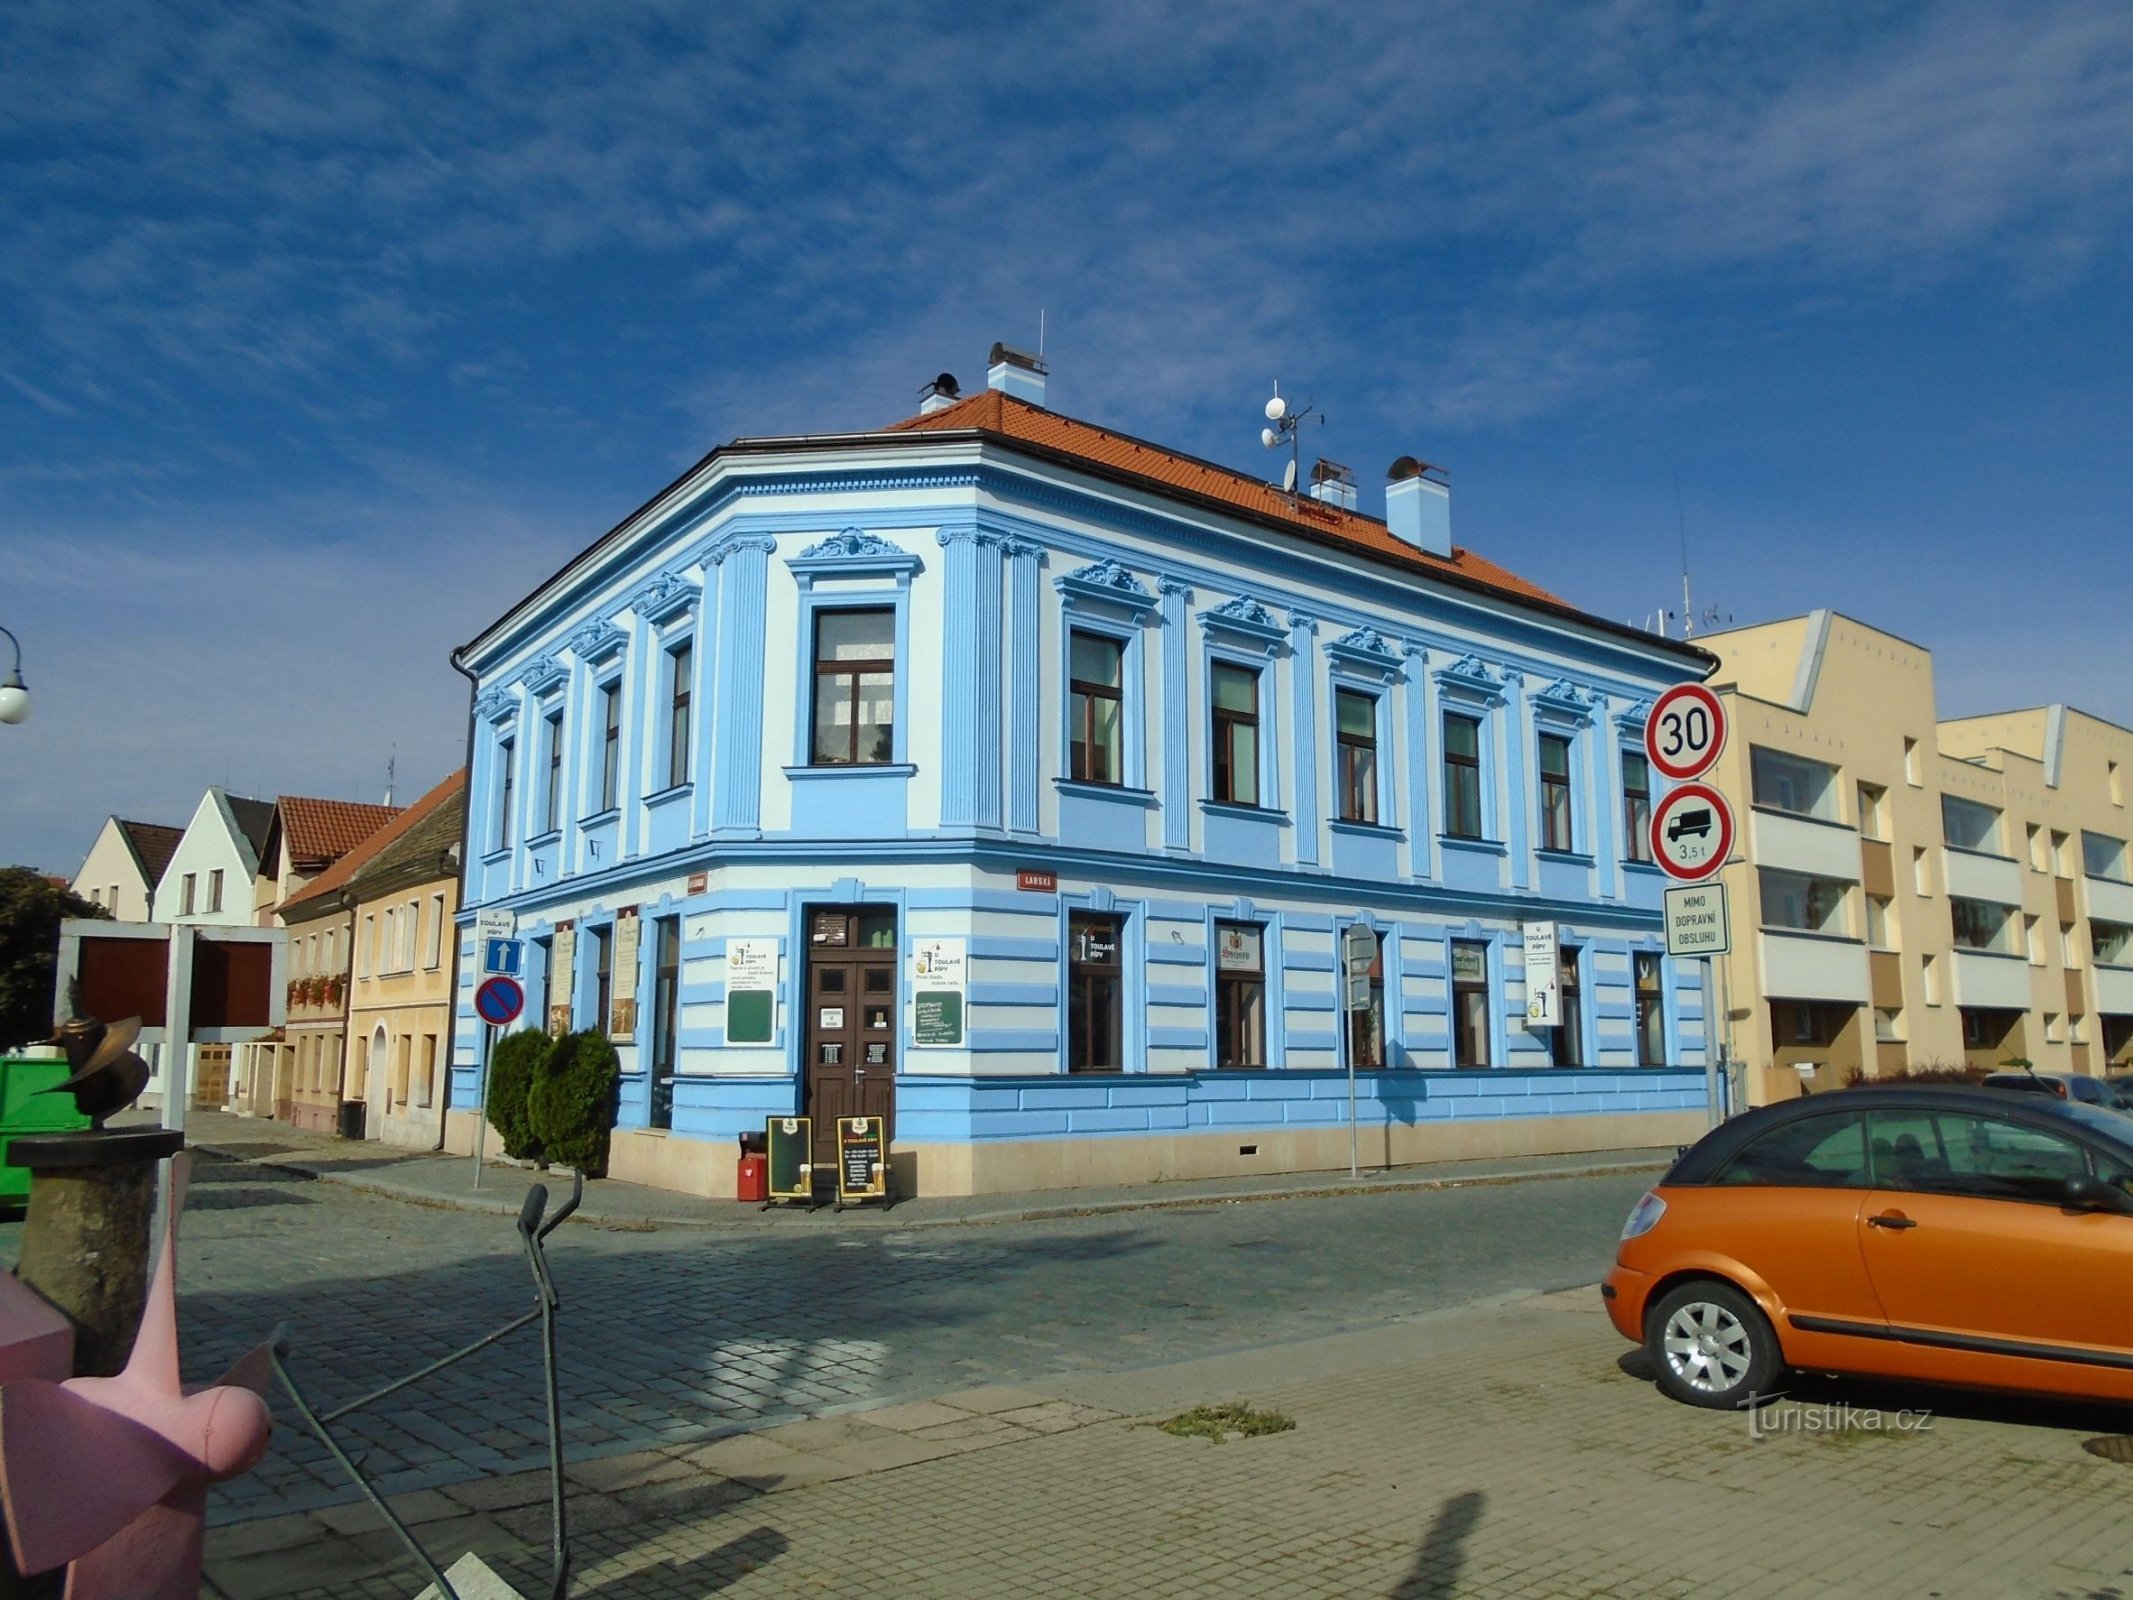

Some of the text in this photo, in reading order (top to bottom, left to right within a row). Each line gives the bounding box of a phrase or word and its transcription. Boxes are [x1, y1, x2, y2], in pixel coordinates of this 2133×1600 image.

[1661, 706, 1709, 756] 30
[1679, 844, 1698, 860] 3,5
[1683, 896, 1706, 908] MIMO
[1675, 910, 1716, 928] DOPRAVNÍ
[1678, 927, 1716, 945] OBSLUHU
[1090, 942, 1115, 951] TOULAVÉ
